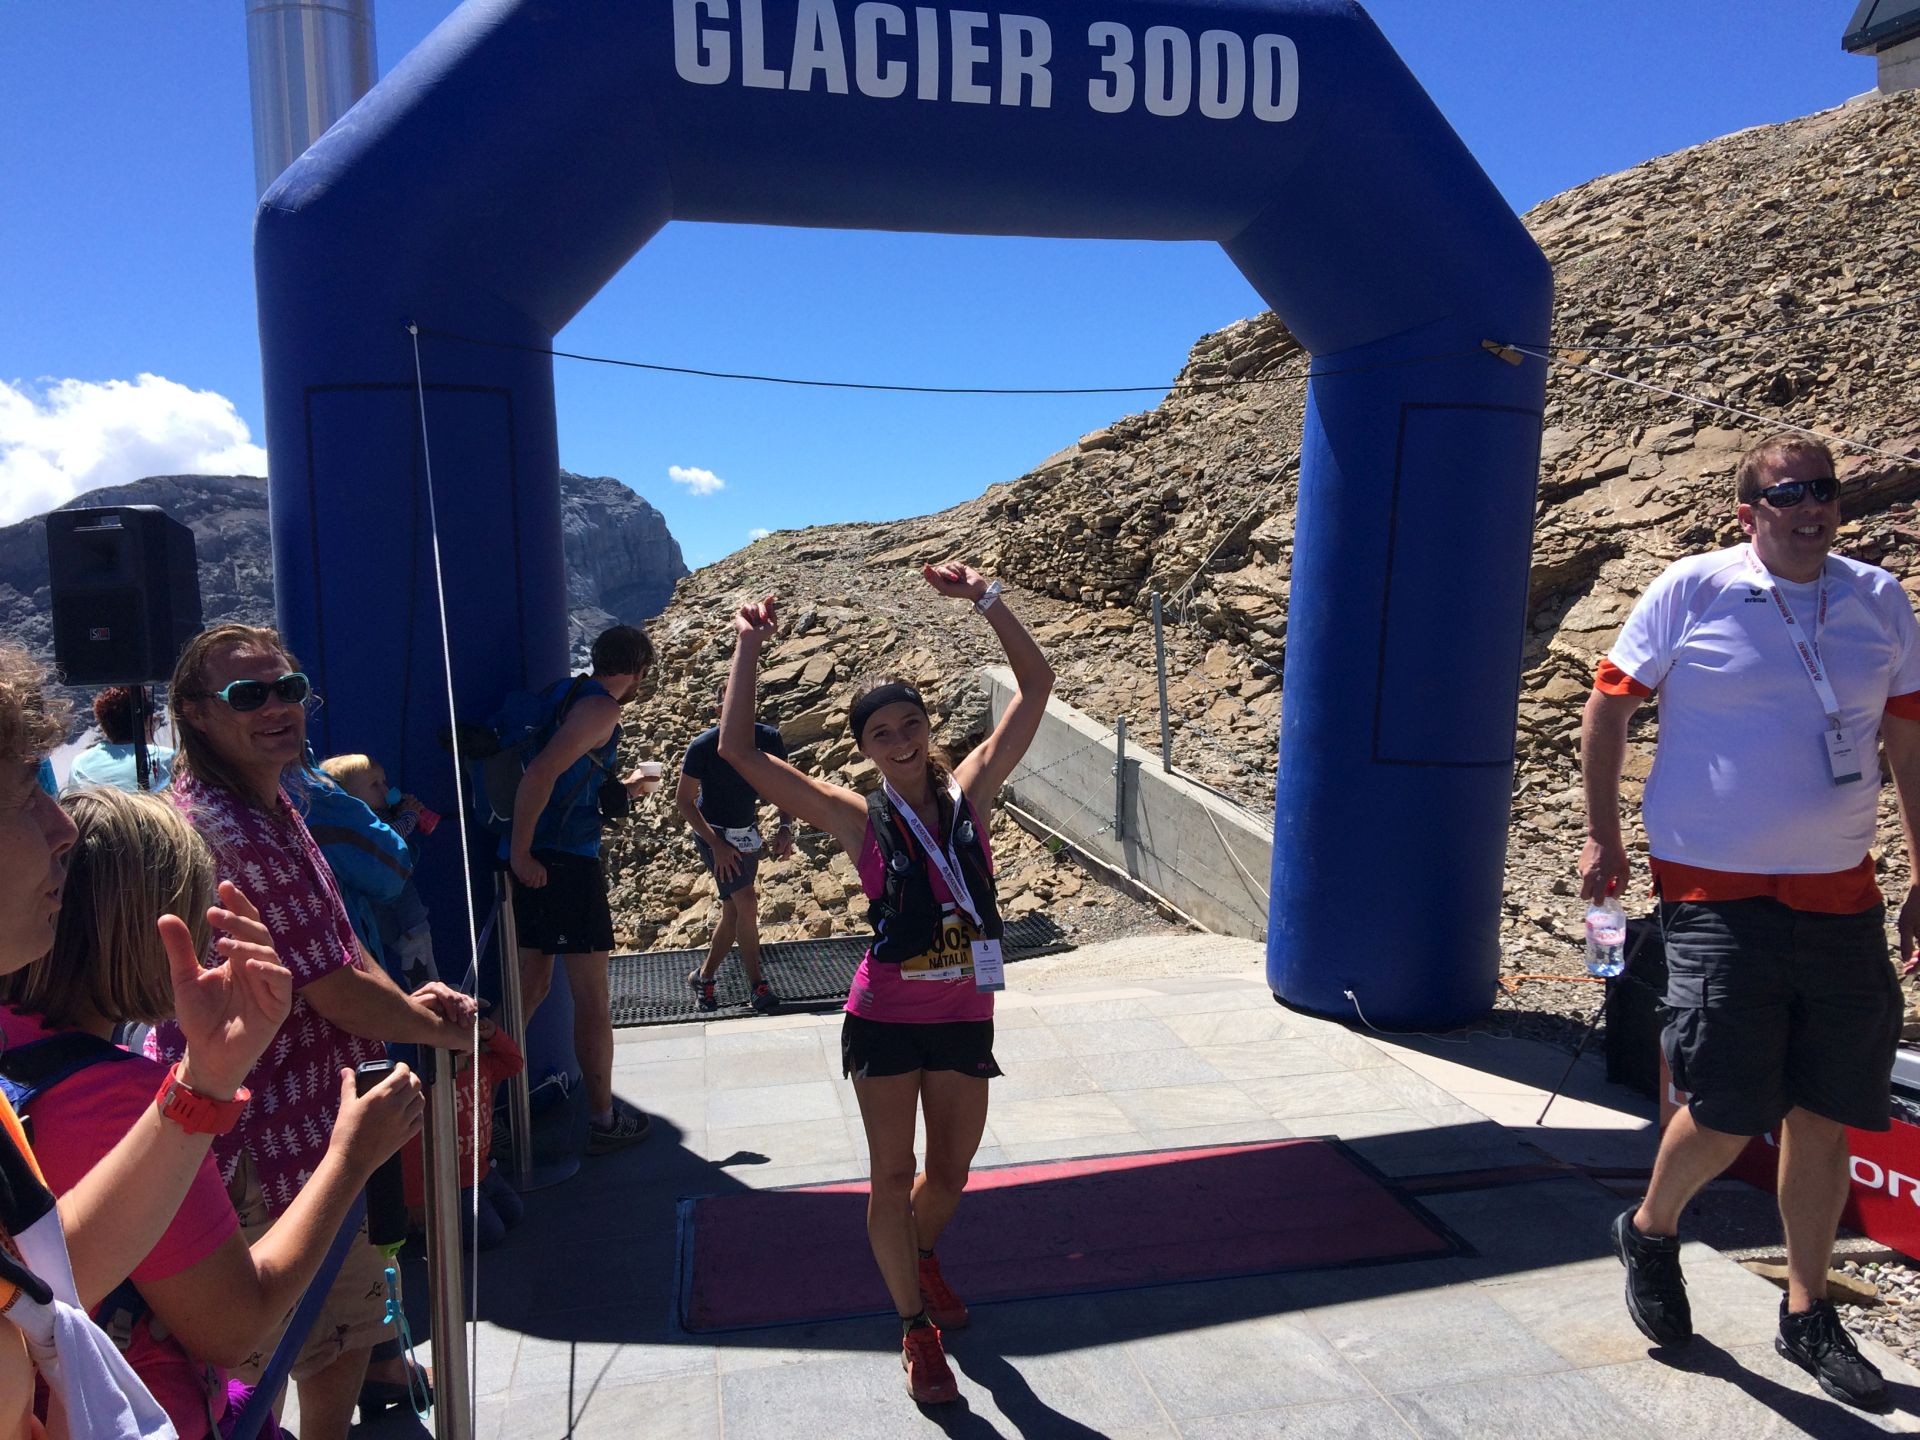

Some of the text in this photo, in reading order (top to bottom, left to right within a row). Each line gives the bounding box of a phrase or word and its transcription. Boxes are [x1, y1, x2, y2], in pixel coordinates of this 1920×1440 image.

[673, 0, 1299, 122] GLACIER 3000
[928, 952, 969, 969] NATALIA
